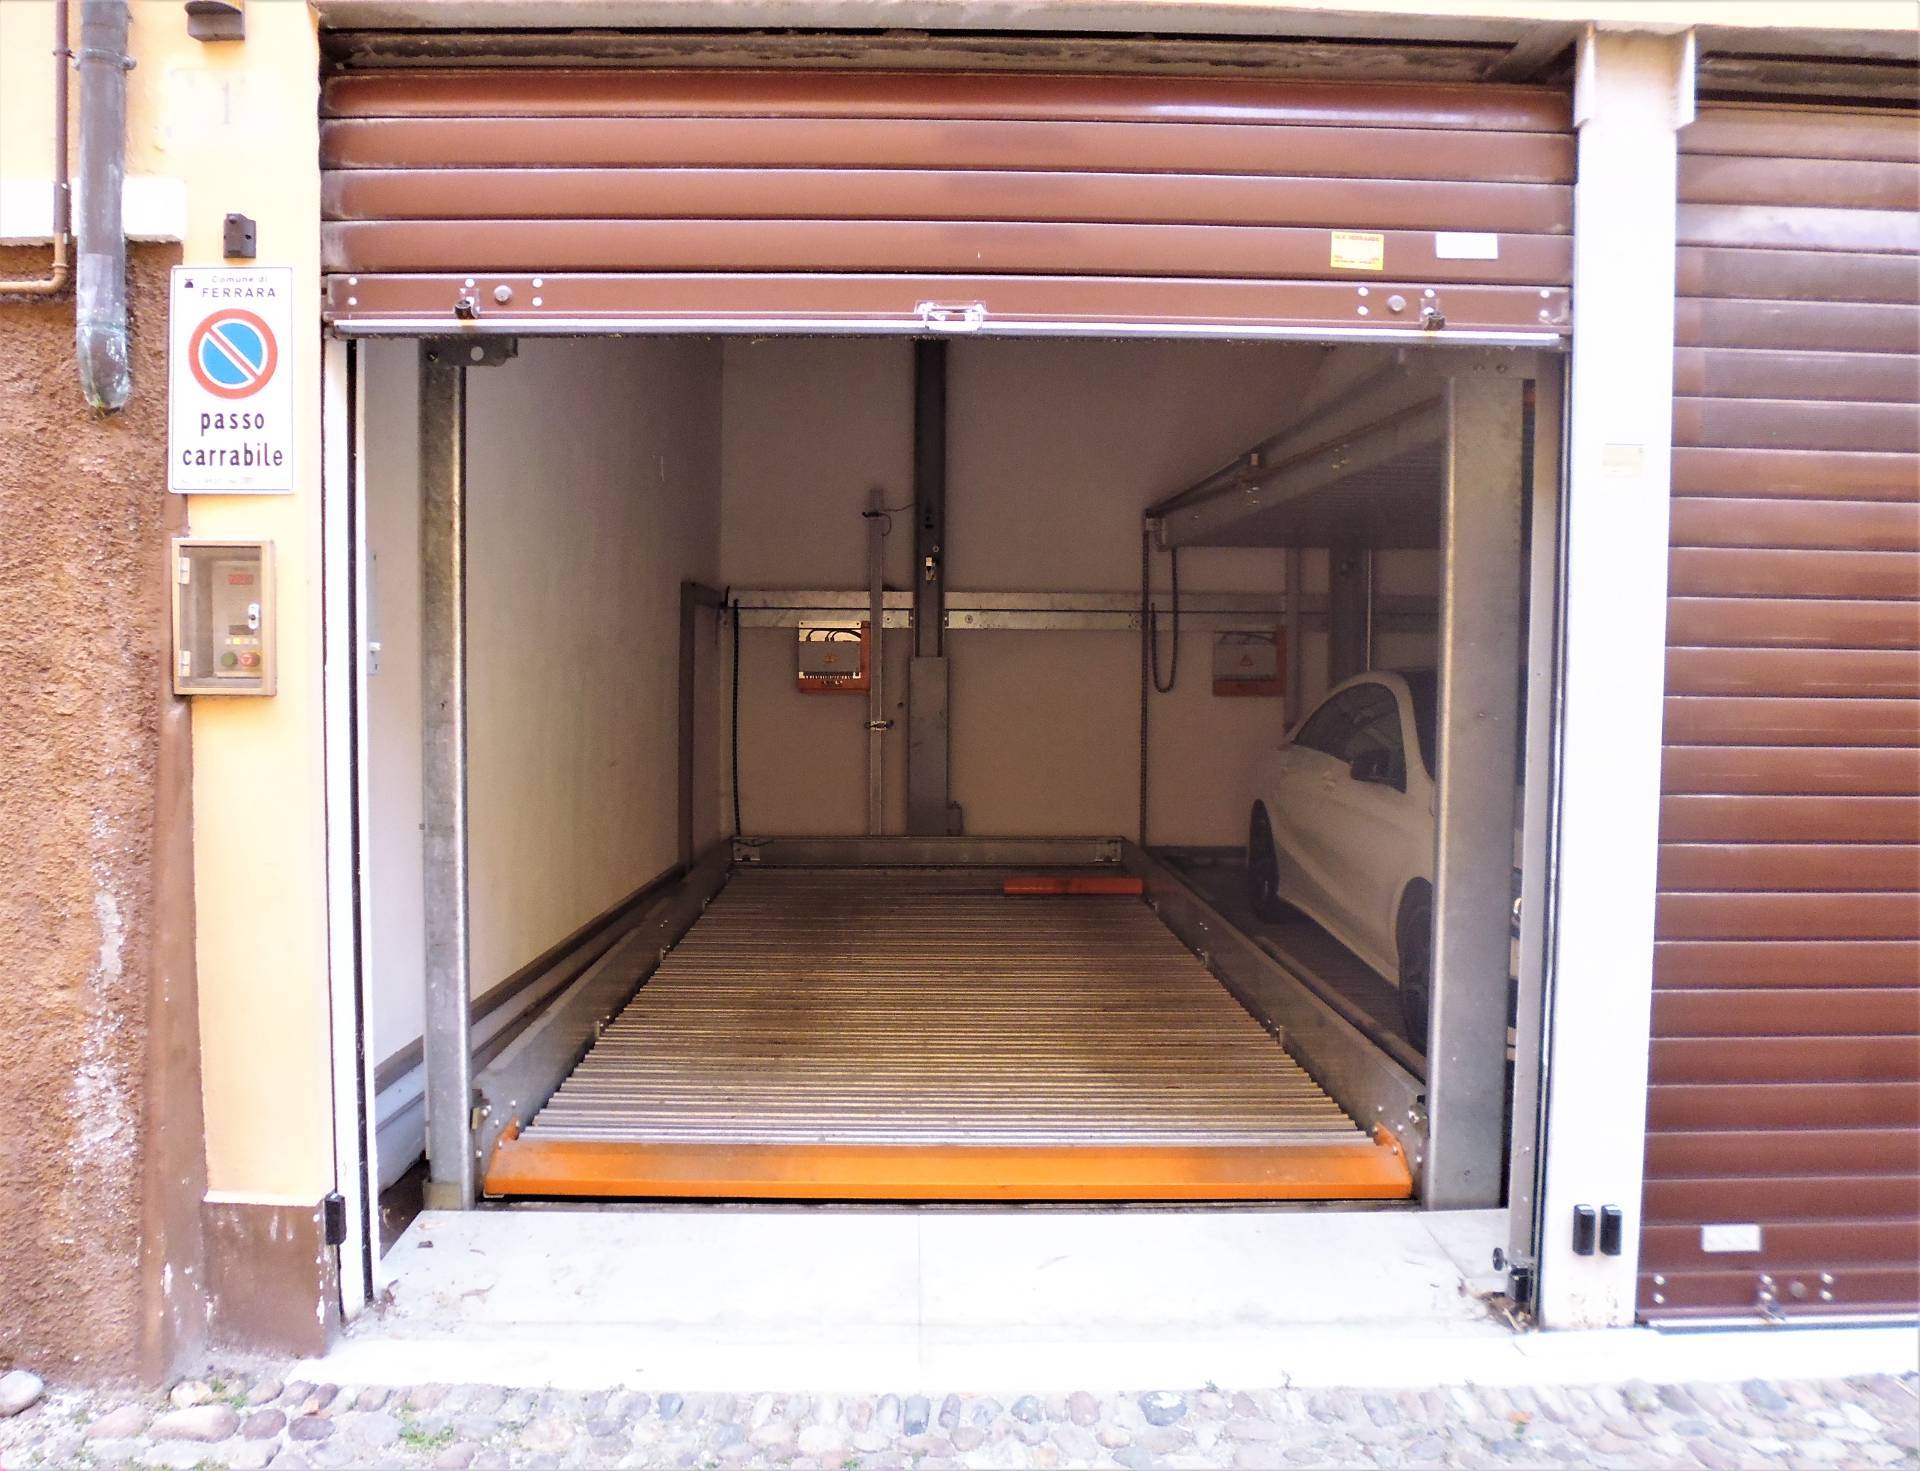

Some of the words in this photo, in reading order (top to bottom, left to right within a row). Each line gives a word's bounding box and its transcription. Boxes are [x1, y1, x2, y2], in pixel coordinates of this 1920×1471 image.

[211, 275, 254, 284] Comune
[202, 287, 276, 298] FERRARA
[200, 412, 265, 437] passo
[182, 442, 283, 467] carrabile
